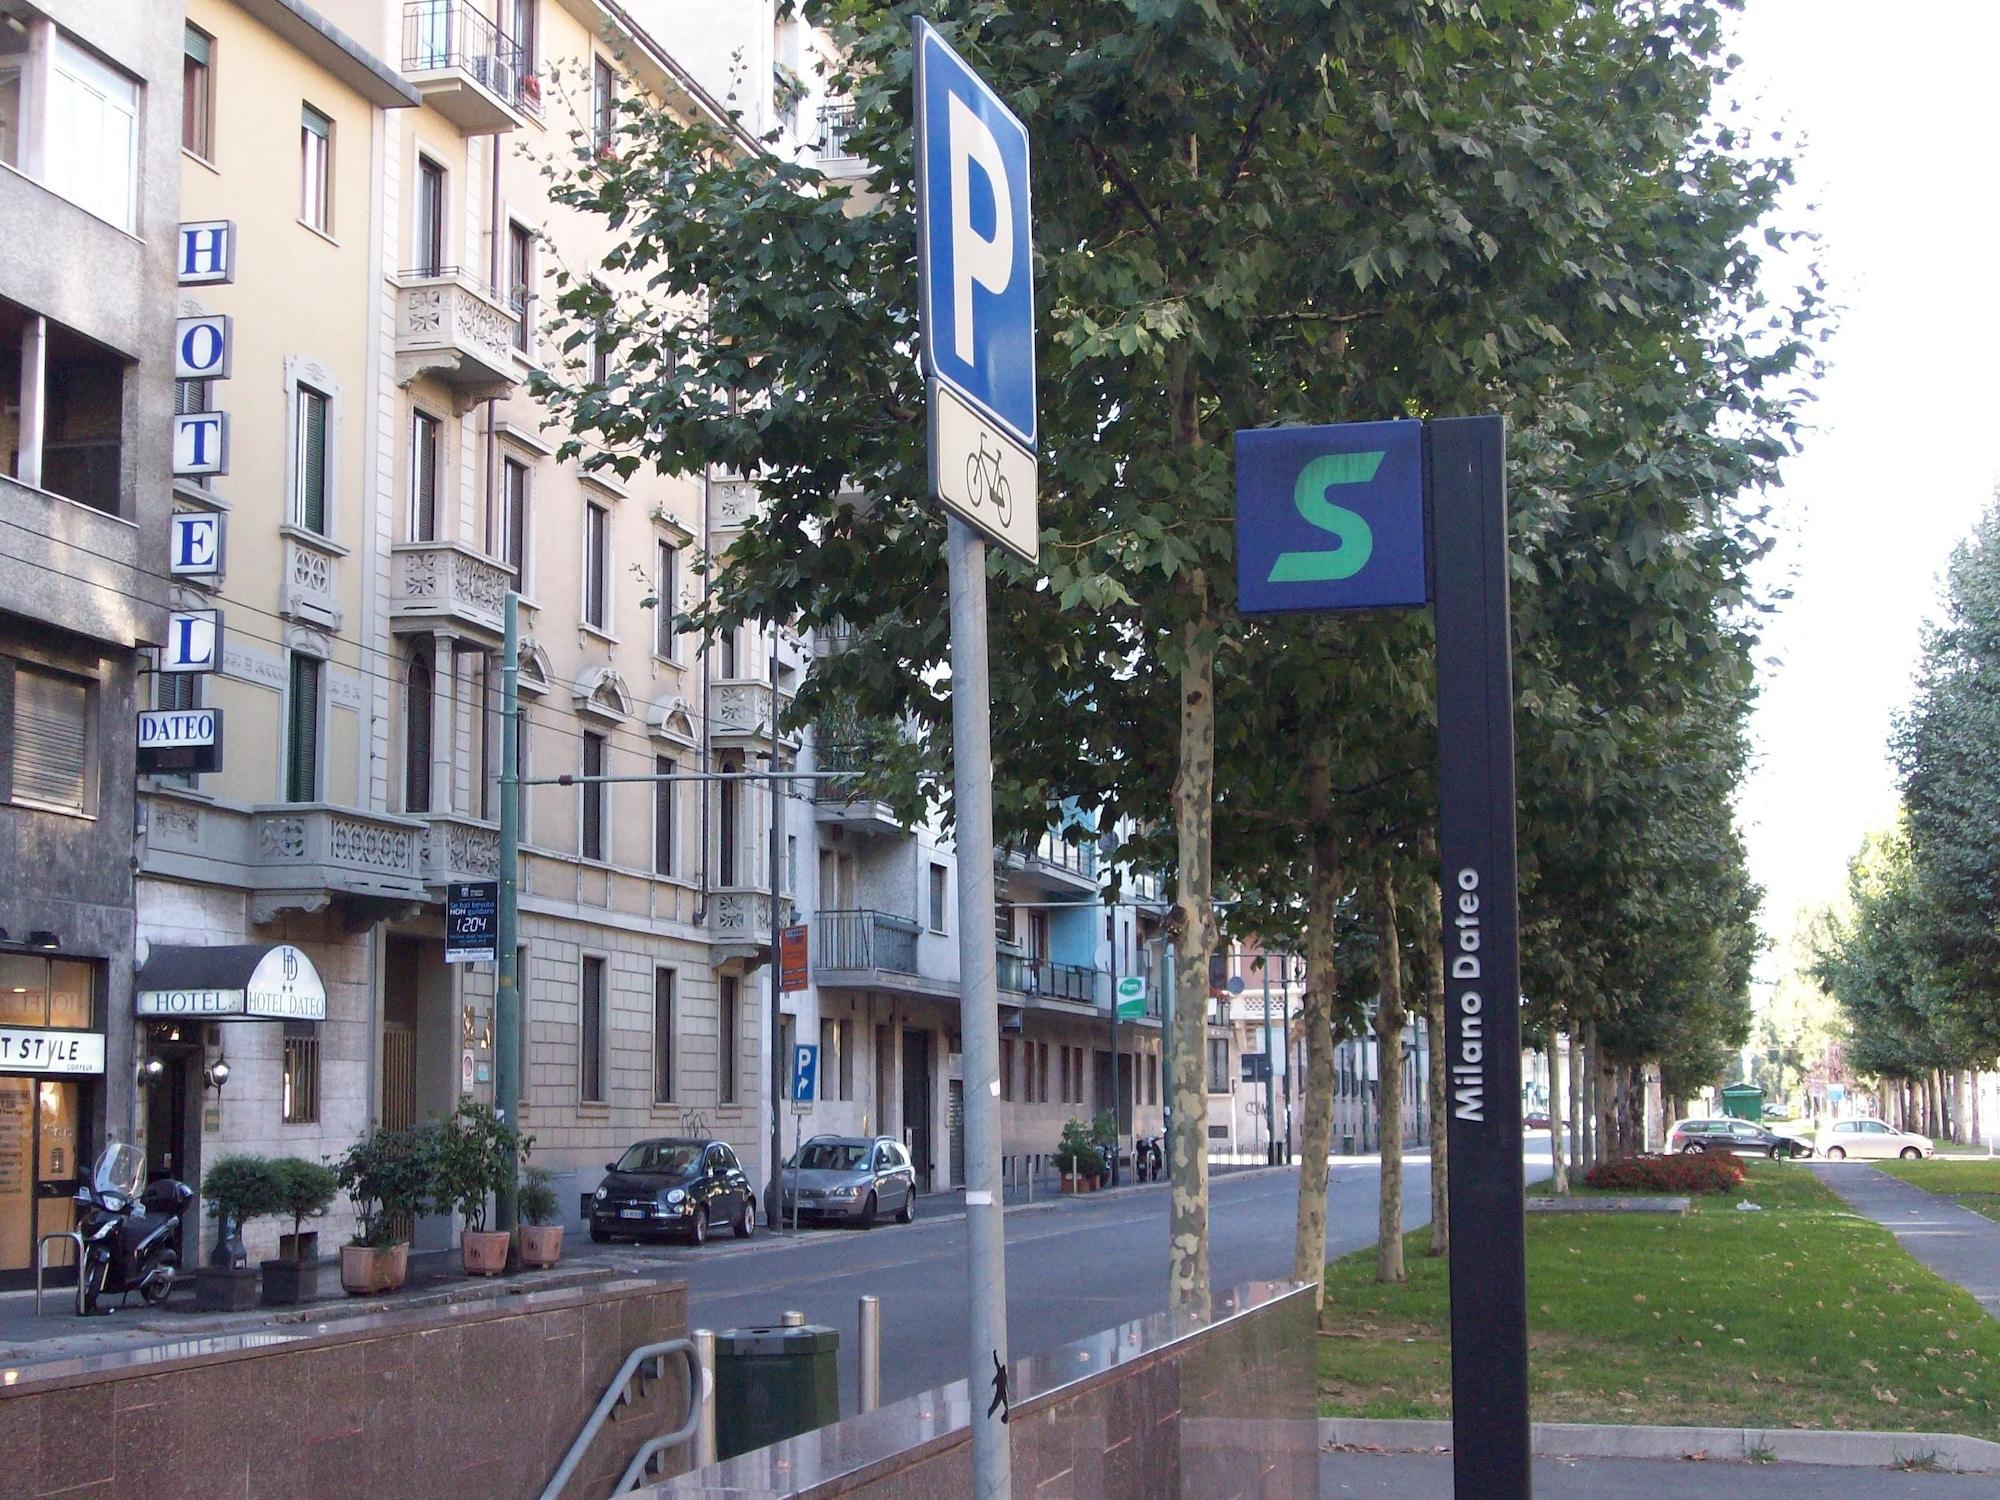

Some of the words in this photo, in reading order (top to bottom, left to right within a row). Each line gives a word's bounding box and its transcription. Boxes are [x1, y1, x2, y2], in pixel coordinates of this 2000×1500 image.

[948, 89, 1014, 367] P
[173, 228, 228, 666] HOTEL
[1266, 451, 1386, 582] S
[141, 714, 214, 742] DATEO
[1452, 867, 1481, 979] Dateo
[155, 992, 226, 1012] HOTEL
[249, 992, 286, 1014] HOTEL
[289, 996, 325, 1017] DATEO
[19, 1038, 79, 1061] STYLE
[798, 1048, 812, 1076] P
[1452, 990, 1484, 1122] Milano
